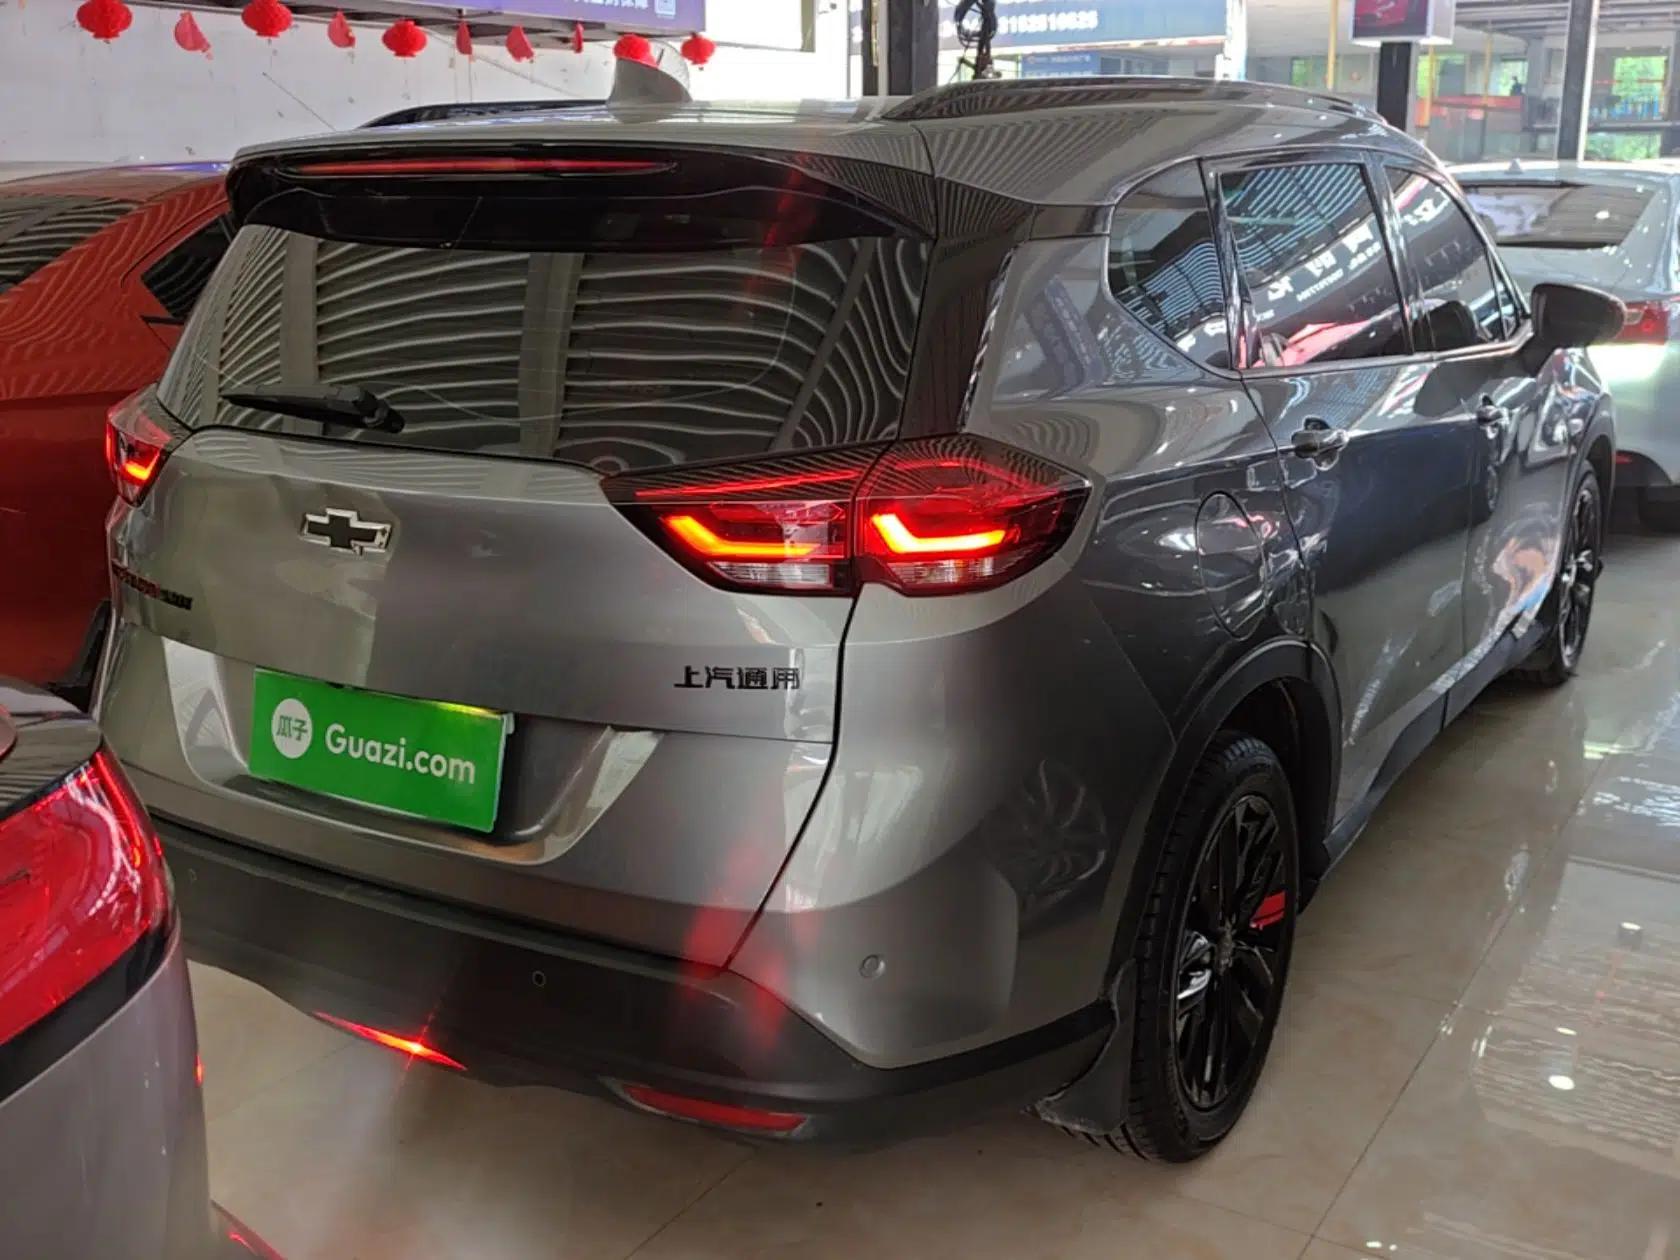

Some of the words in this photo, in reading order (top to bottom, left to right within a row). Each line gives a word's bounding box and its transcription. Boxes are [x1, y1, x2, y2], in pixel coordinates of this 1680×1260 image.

[673, 665, 800, 690] 上汽通用
[275, 714, 309, 742] 瓜子
[324, 722, 476, 785] Guazi.com
